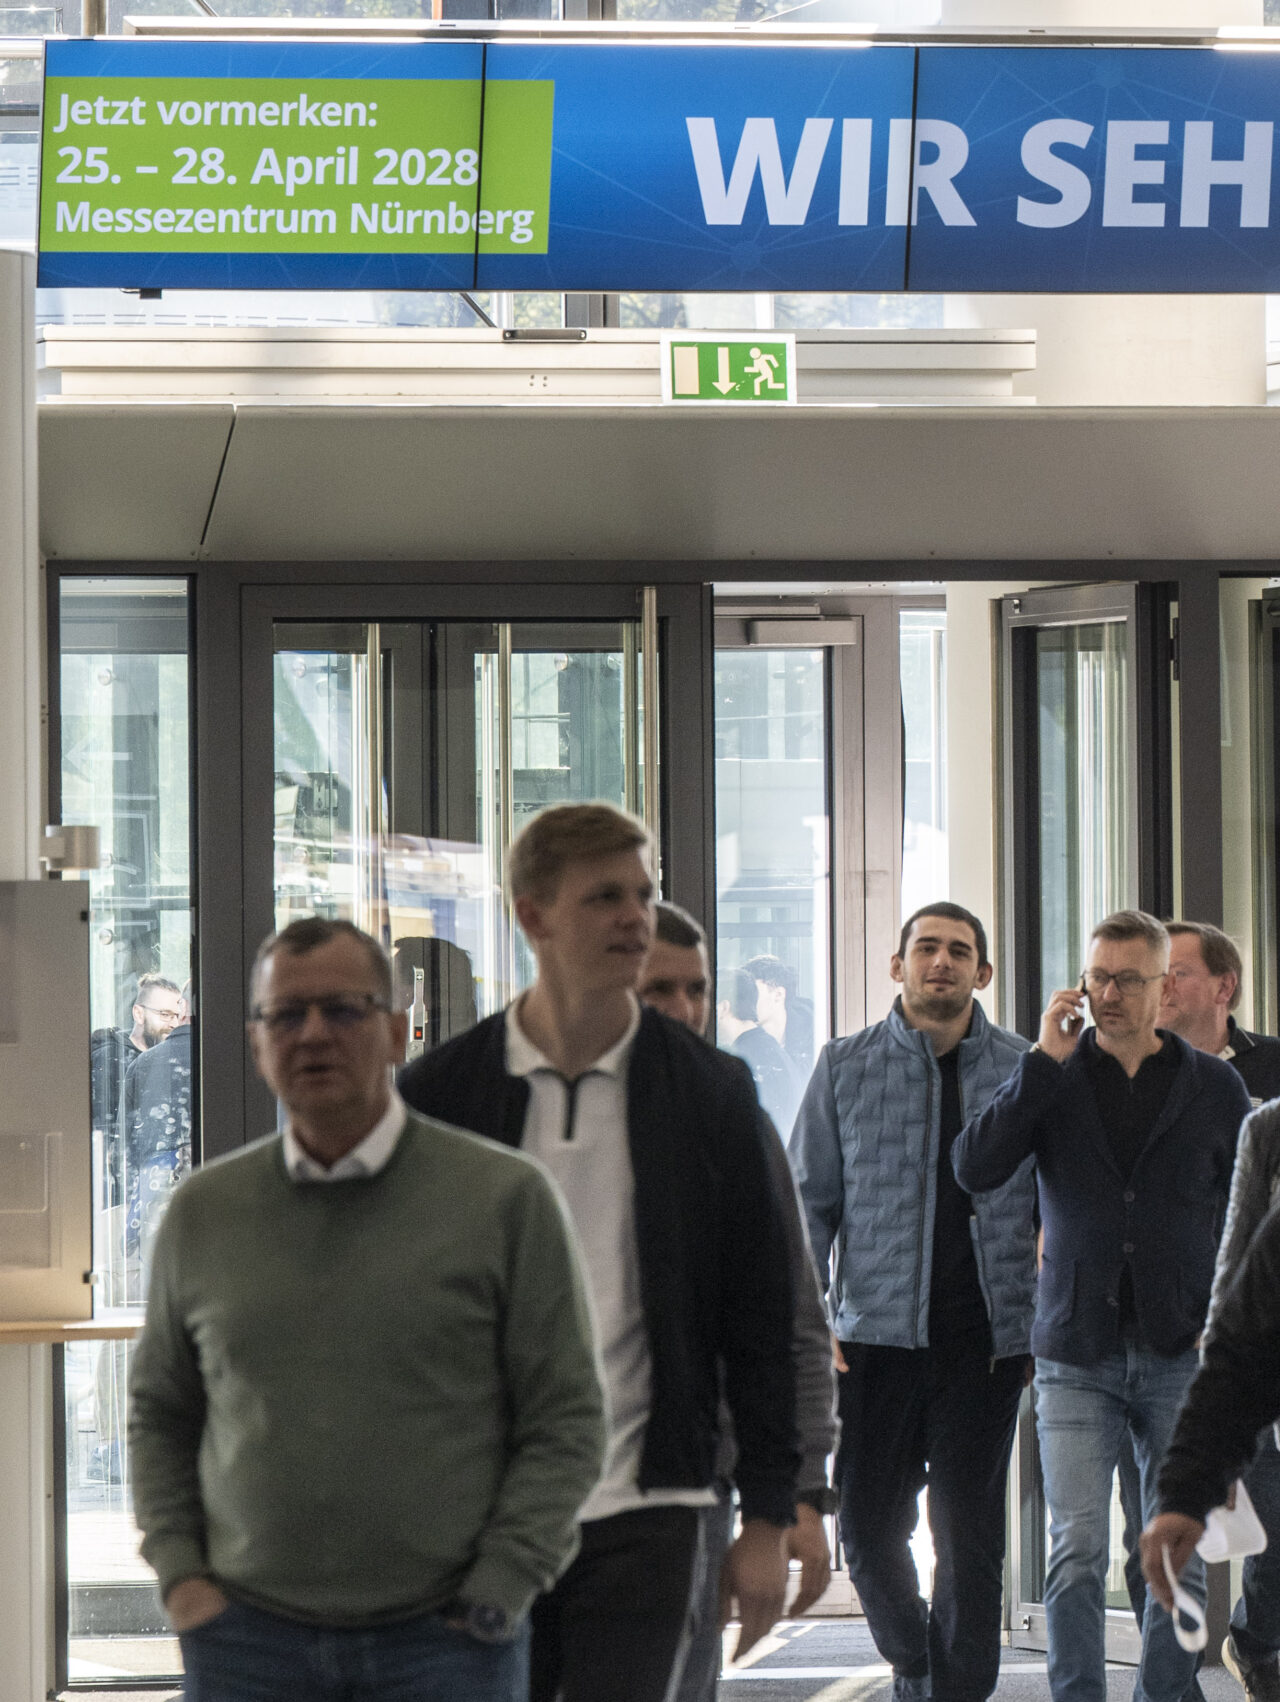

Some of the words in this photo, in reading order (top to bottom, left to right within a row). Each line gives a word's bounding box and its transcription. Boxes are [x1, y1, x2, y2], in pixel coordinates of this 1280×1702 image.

[53, 94, 147, 133] Jetzt
[157, 94, 378, 127] vormerken:
[56, 146, 121, 185] 25.
[171, 146, 237, 185] 28.
[250, 146, 359, 197] April
[372, 147, 479, 186] 2028
[686, 117, 978, 226] WIR
[55, 201, 337, 234] Messezentrum
[350, 201, 535, 244] Nürnberg
